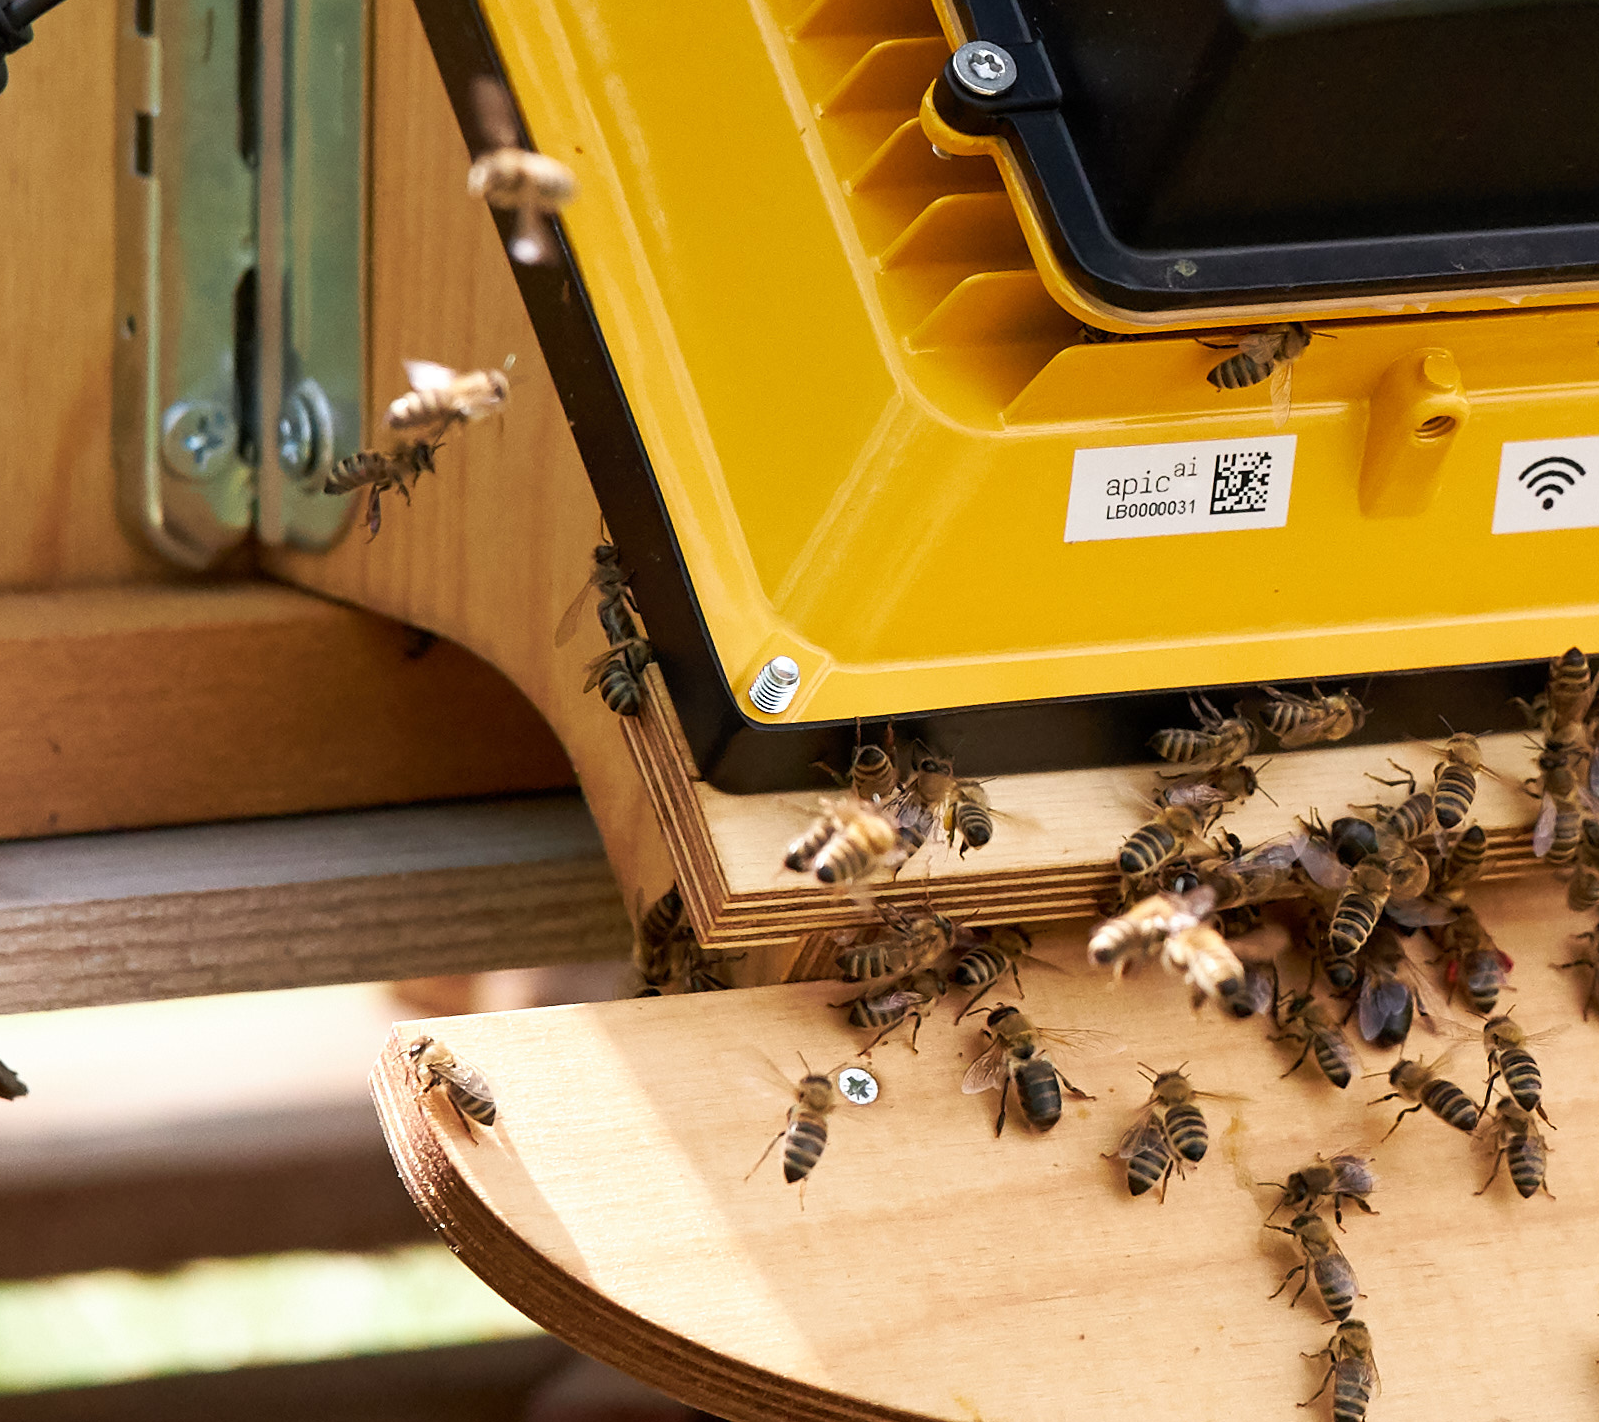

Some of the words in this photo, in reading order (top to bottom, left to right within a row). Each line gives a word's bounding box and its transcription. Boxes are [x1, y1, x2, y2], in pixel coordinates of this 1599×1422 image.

[1106, 470, 1171, 501] apic
[1174, 456, 1198, 477] ai
[1106, 499, 1196, 520] LB0000031
